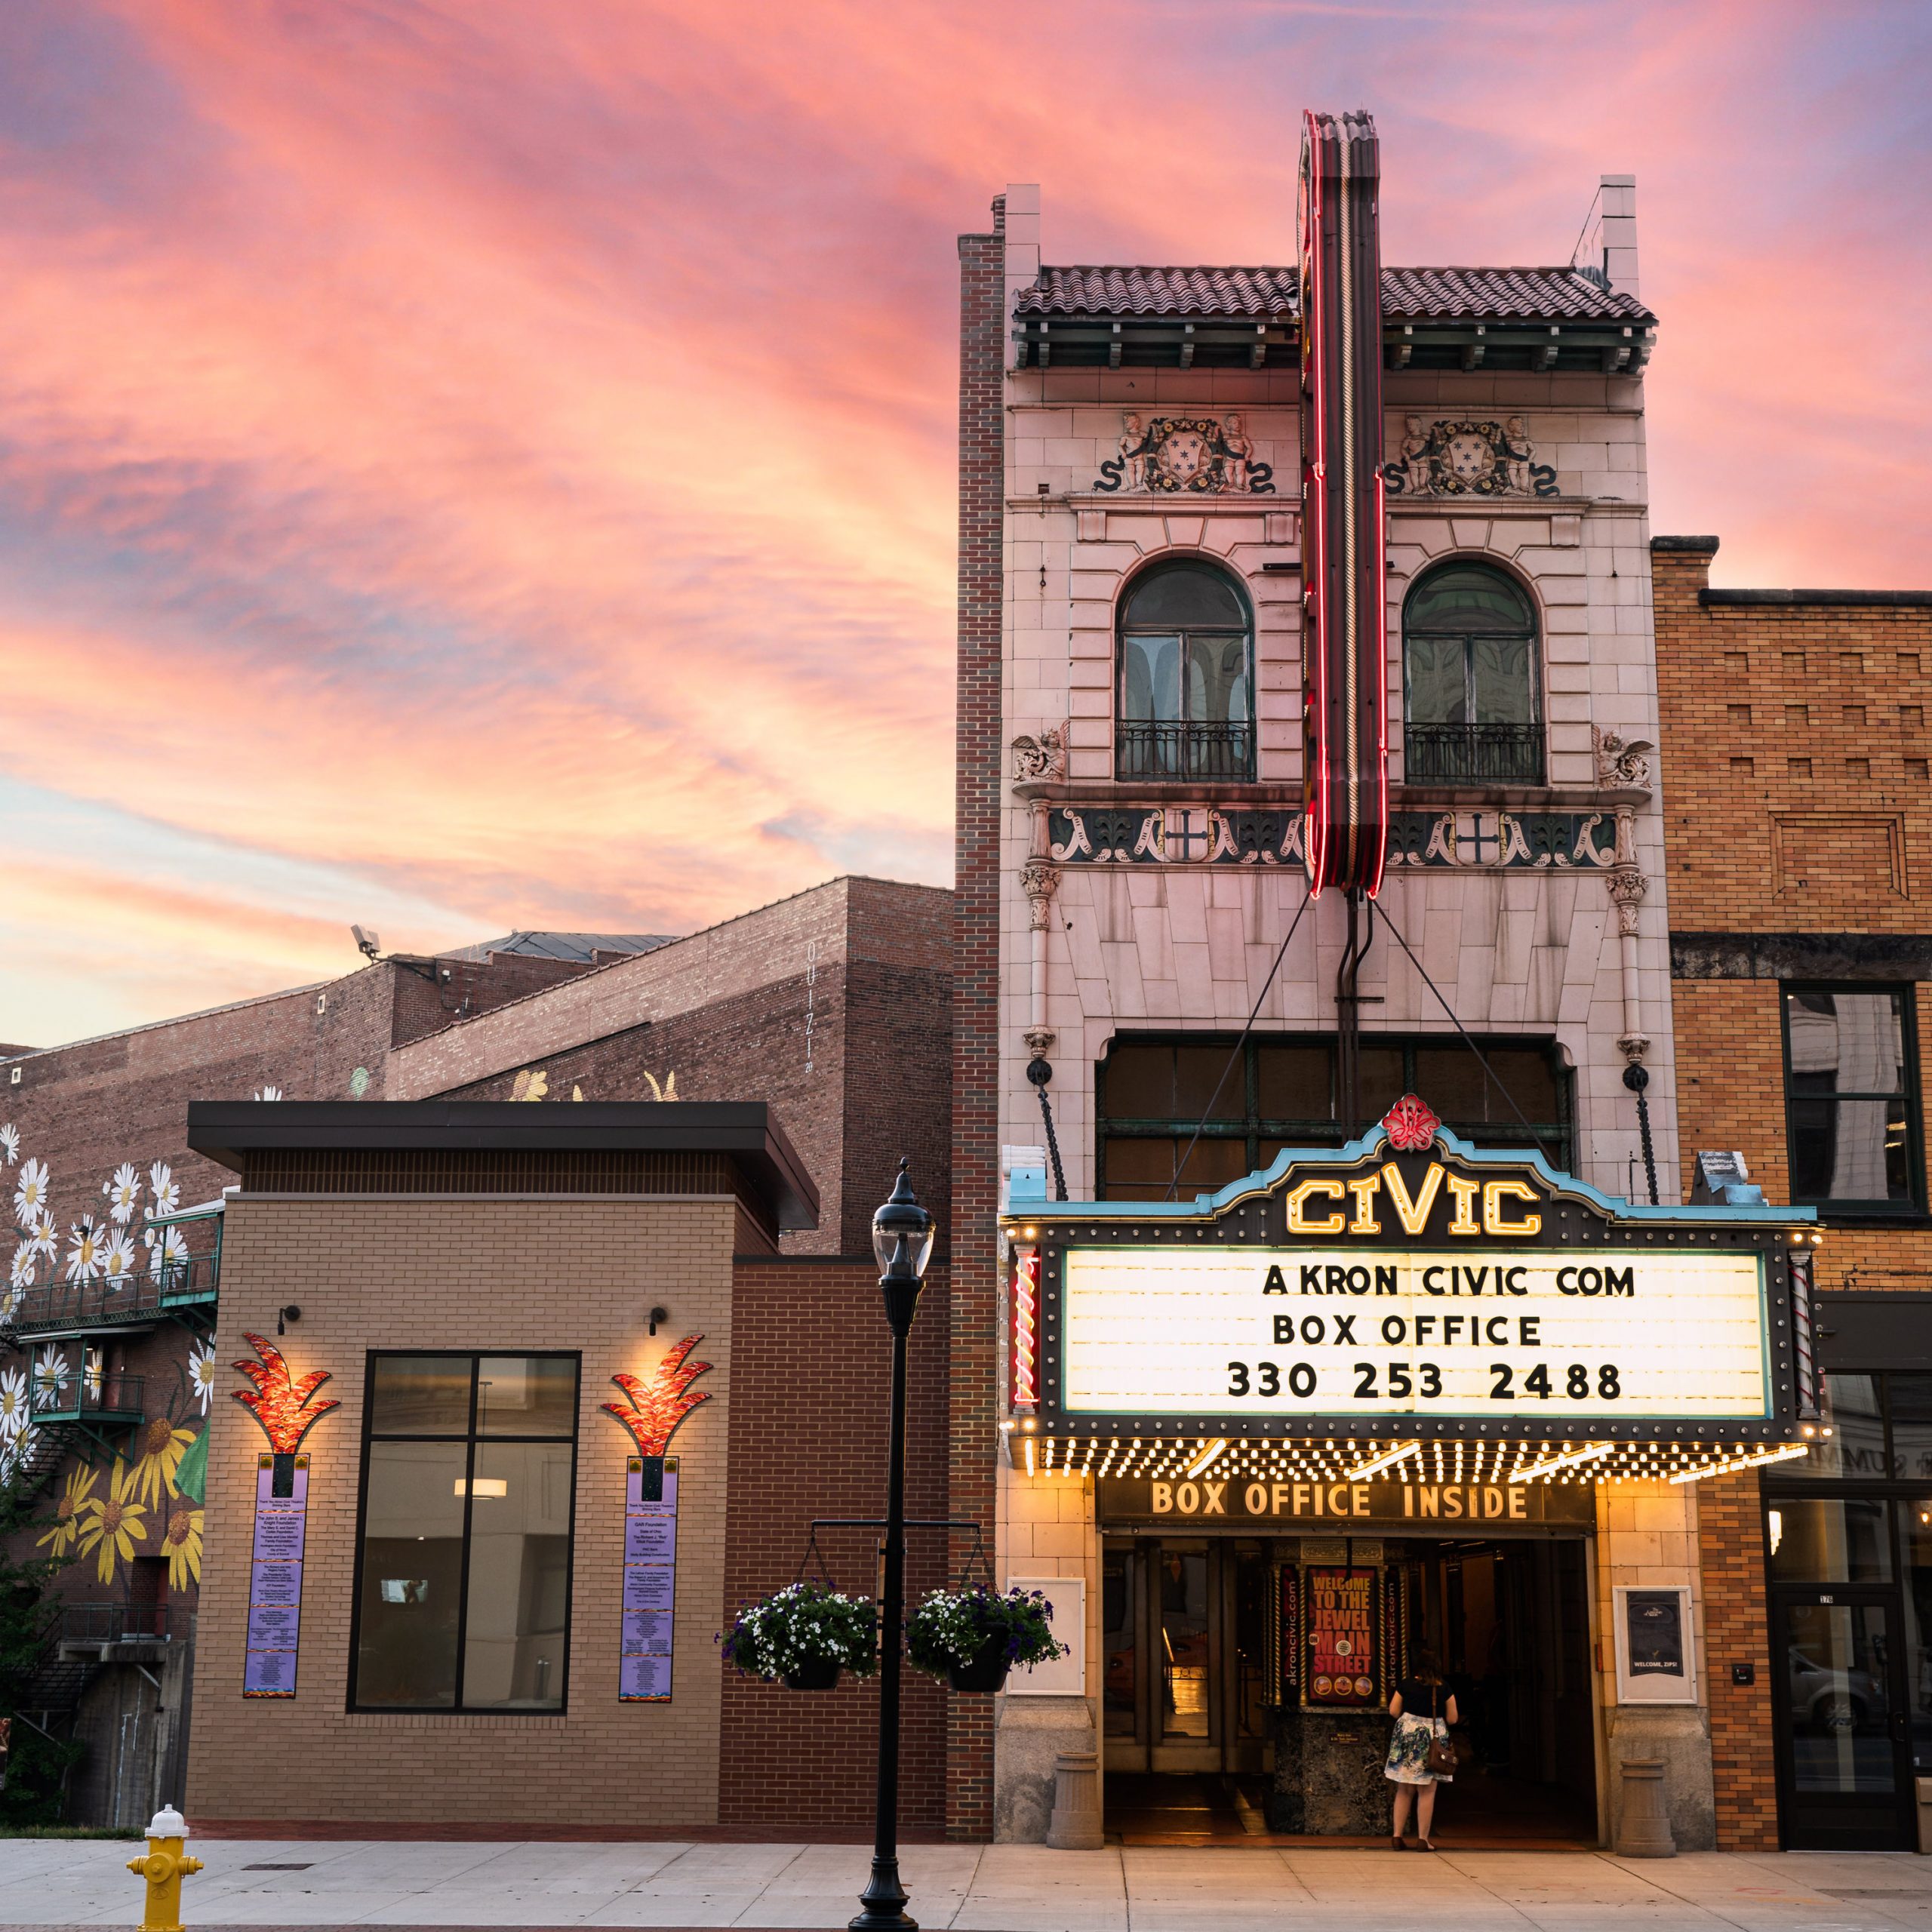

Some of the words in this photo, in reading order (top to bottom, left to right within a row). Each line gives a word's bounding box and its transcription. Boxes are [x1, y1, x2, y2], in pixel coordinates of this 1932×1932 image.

[1286, 1161, 1541, 1235] CIVIC
[1423, 1266, 1527, 1296] CIVIC
[1557, 1266, 1634, 1297] COM
[1274, 1315, 1357, 1345] BOX
[1382, 1315, 1540, 1346] OFFICE
[1229, 1362, 1316, 1398] 330
[1354, 1363, 1441, 1398] 253
[1491, 1364, 1620, 1399] 2488
[1152, 1482, 1226, 1514] BOX
[1246, 1484, 1371, 1515] OFFICE
[1404, 1486, 1527, 1518] INSIDE
[1313, 1577, 1370, 1591] WELCOME
[1314, 1591, 1335, 1609] TO
[1339, 1591, 1370, 1610] THE
[1286, 1581, 1297, 1685] akroncivic.com
[1314, 1610, 1370, 1630] JEWEL
[1387, 1583, 1396, 1687] akroncivic.com
[1315, 1631, 1370, 1654] MAIN
[1313, 1655, 1371, 1672] STREET
